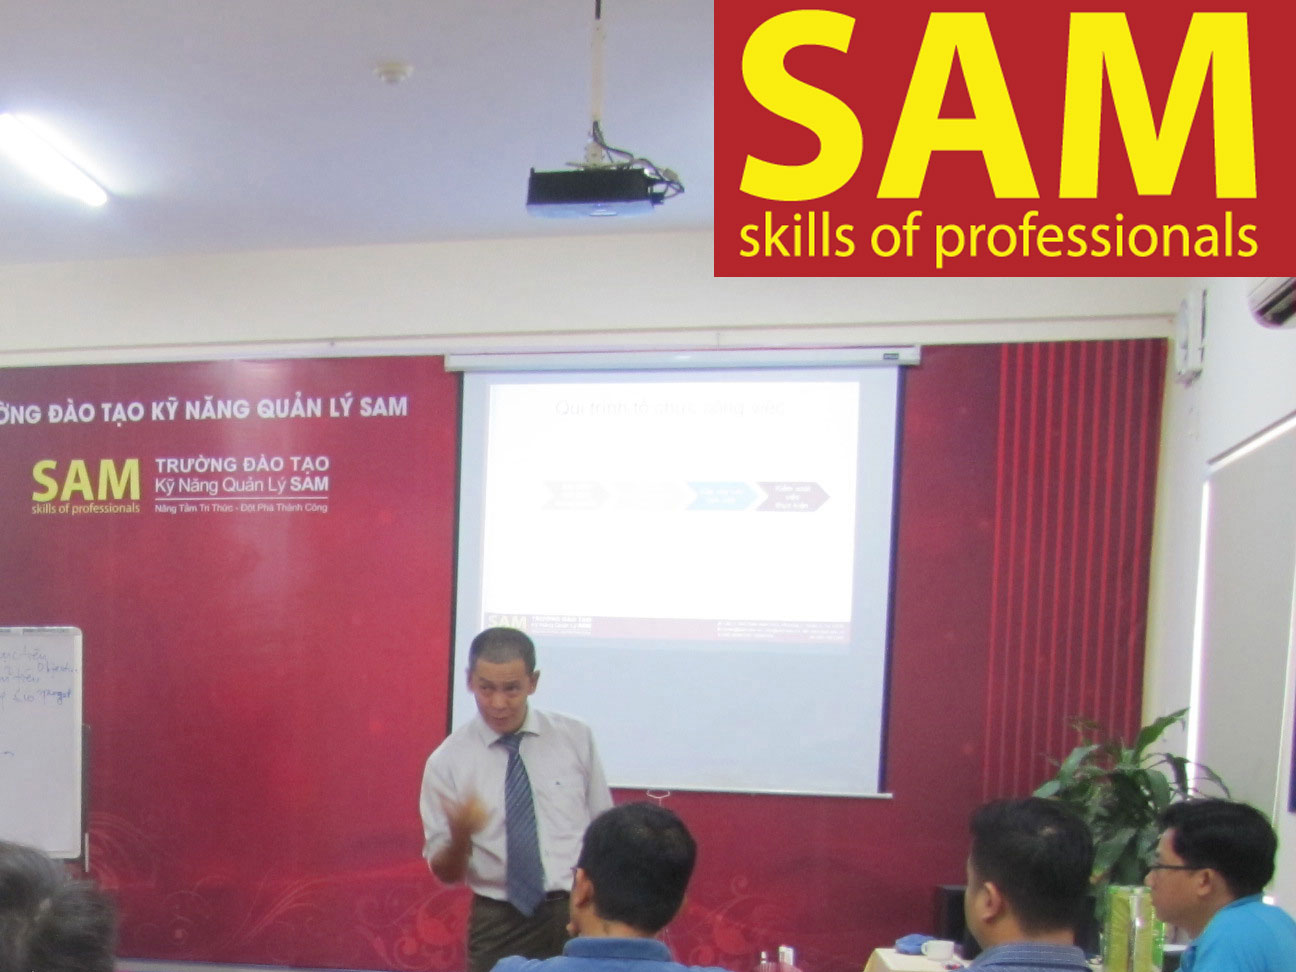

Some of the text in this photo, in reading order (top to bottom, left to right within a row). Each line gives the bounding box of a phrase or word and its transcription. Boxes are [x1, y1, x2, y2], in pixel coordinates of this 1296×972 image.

[48, 397, 95, 424] ĐÀO
[102, 402, 144, 427] TẠO
[152, 397, 179, 420] KỸ
[185, 395, 250, 420] NĂNG
[257, 391, 321, 418] QUẢN
[330, 392, 354, 417] LÝ
[360, 397, 407, 417] SAM
[156, 454, 329, 475] TRƯỜNG ĐÀO TẠO
[32, 458, 140, 502] SAM
[156, 475, 329, 496] Kỹ Năng Quản Lý SAM
[32, 502, 140, 515] skills of professionals
